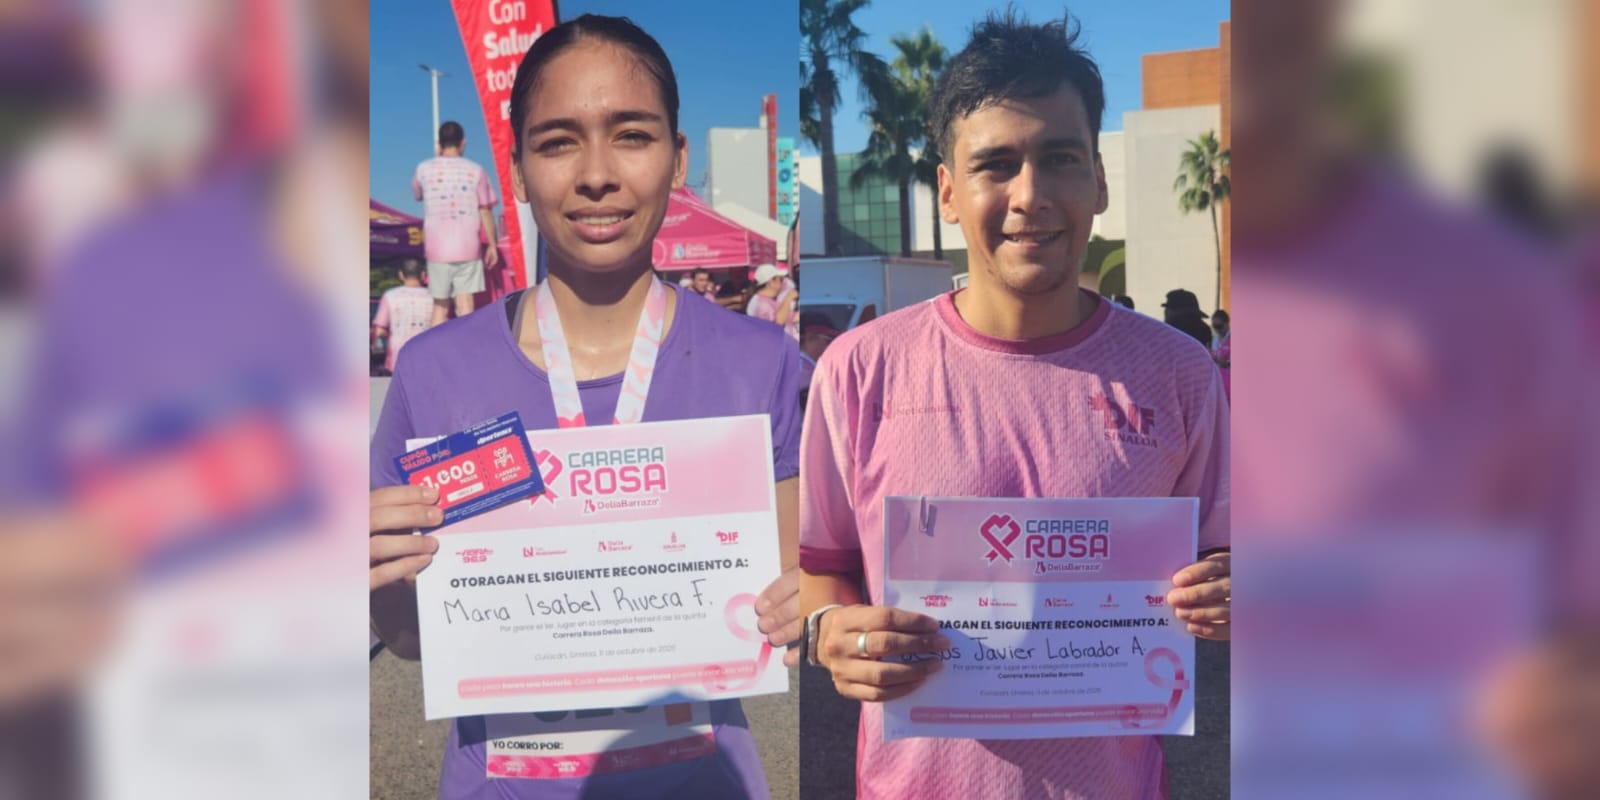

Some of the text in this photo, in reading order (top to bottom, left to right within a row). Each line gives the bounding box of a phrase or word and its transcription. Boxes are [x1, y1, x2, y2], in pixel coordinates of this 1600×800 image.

[489, 0, 526, 25] Con
[1104, 399, 1155, 435] DIF
[1104, 431, 1158, 448] SINALOA
[568, 447, 664, 468] CARRERA
[420, 460, 475, 490] 1,000
[570, 464, 666, 496] ROSA
[720, 532, 739, 542] DIF
[1026, 520, 1109, 533] CARRERA
[1025, 534, 1109, 558] ROSA
[450, 558, 749, 588] OTORAGAN EL SIGUIENTE RECONOCIMIENTO A:
[525, 590, 601, 616] Isabel
[613, 586, 683, 611] Rivera
[691, 578, 713, 606] F.
[552, 631, 582, 639] Carrera
[939, 618, 1168, 630] RAGAN EL SIGUIENTE RECONOCIMIENTO A:
[969, 636, 1036, 661] Javier
[1046, 637, 1120, 660] Labrador
[493, 741, 564, 750] YO CORRO POR:
